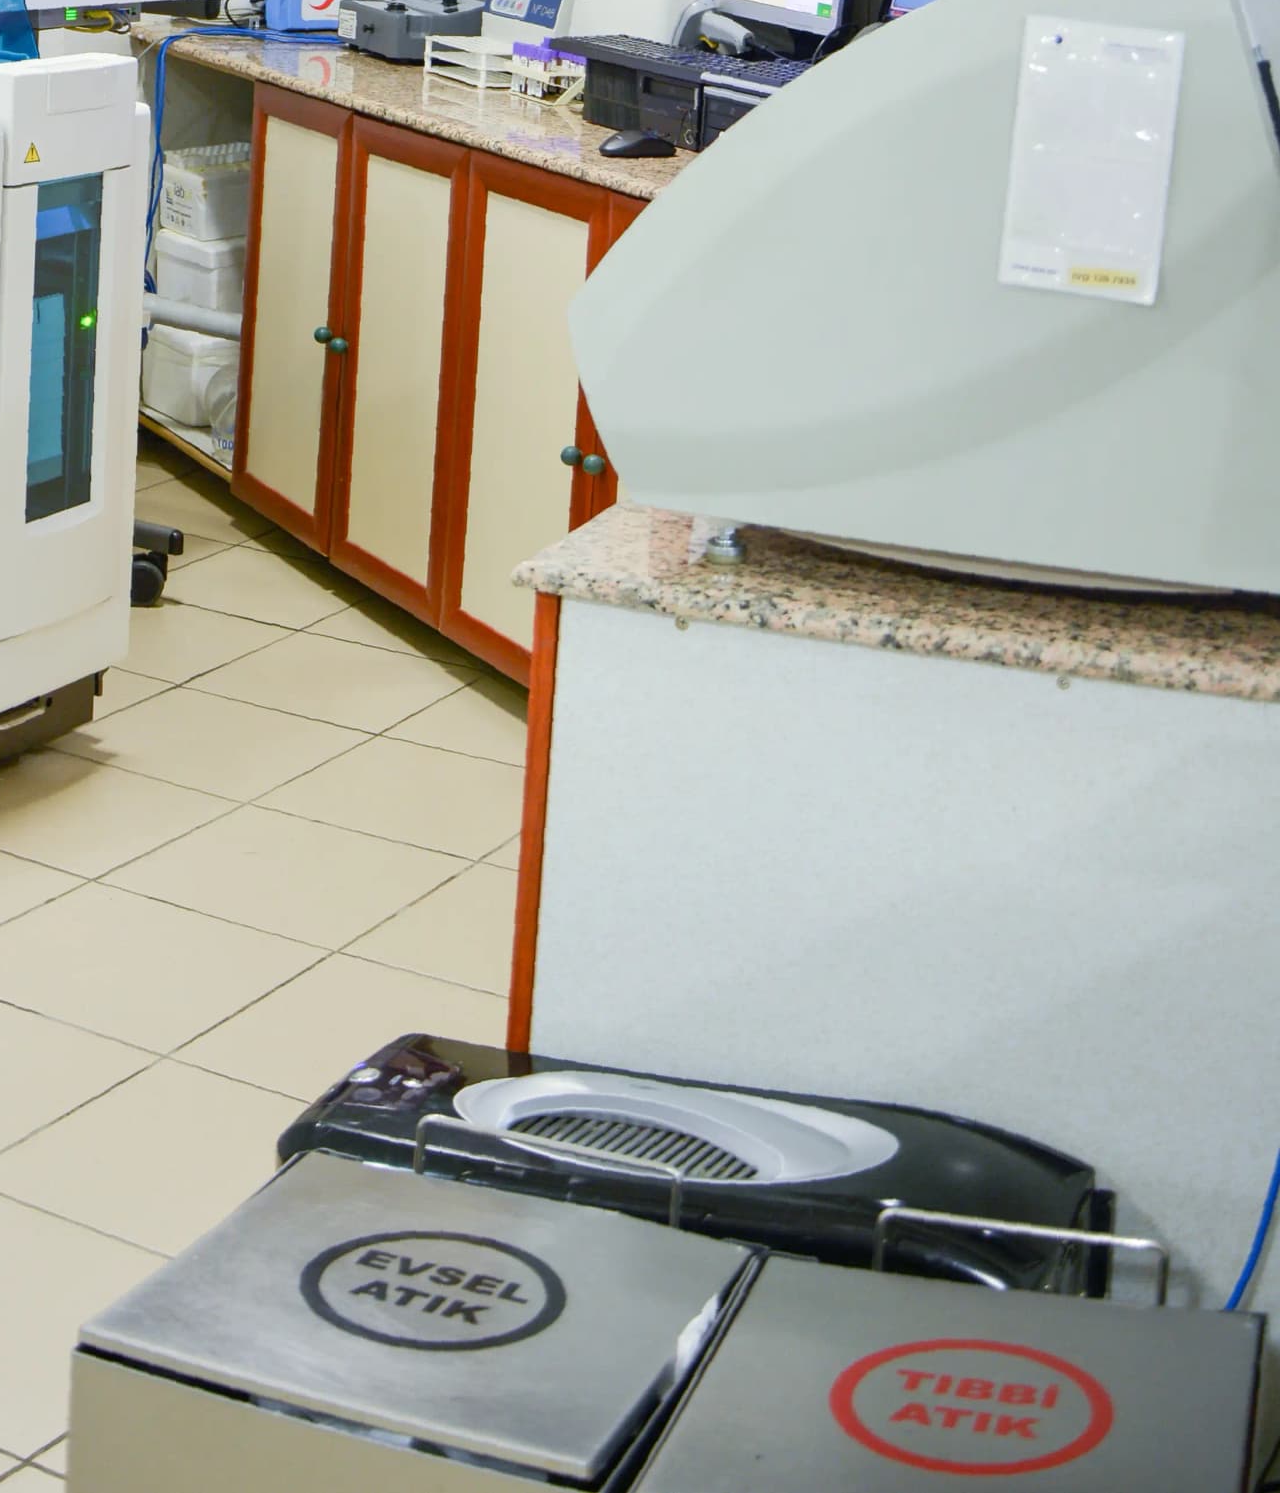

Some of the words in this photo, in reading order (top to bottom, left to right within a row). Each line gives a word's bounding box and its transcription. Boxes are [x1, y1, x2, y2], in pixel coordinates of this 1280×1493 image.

[355, 1249, 529, 1304] EVSEL
[349, 1279, 492, 1325] ATIK
[889, 1402, 1041, 1440] ATIK
